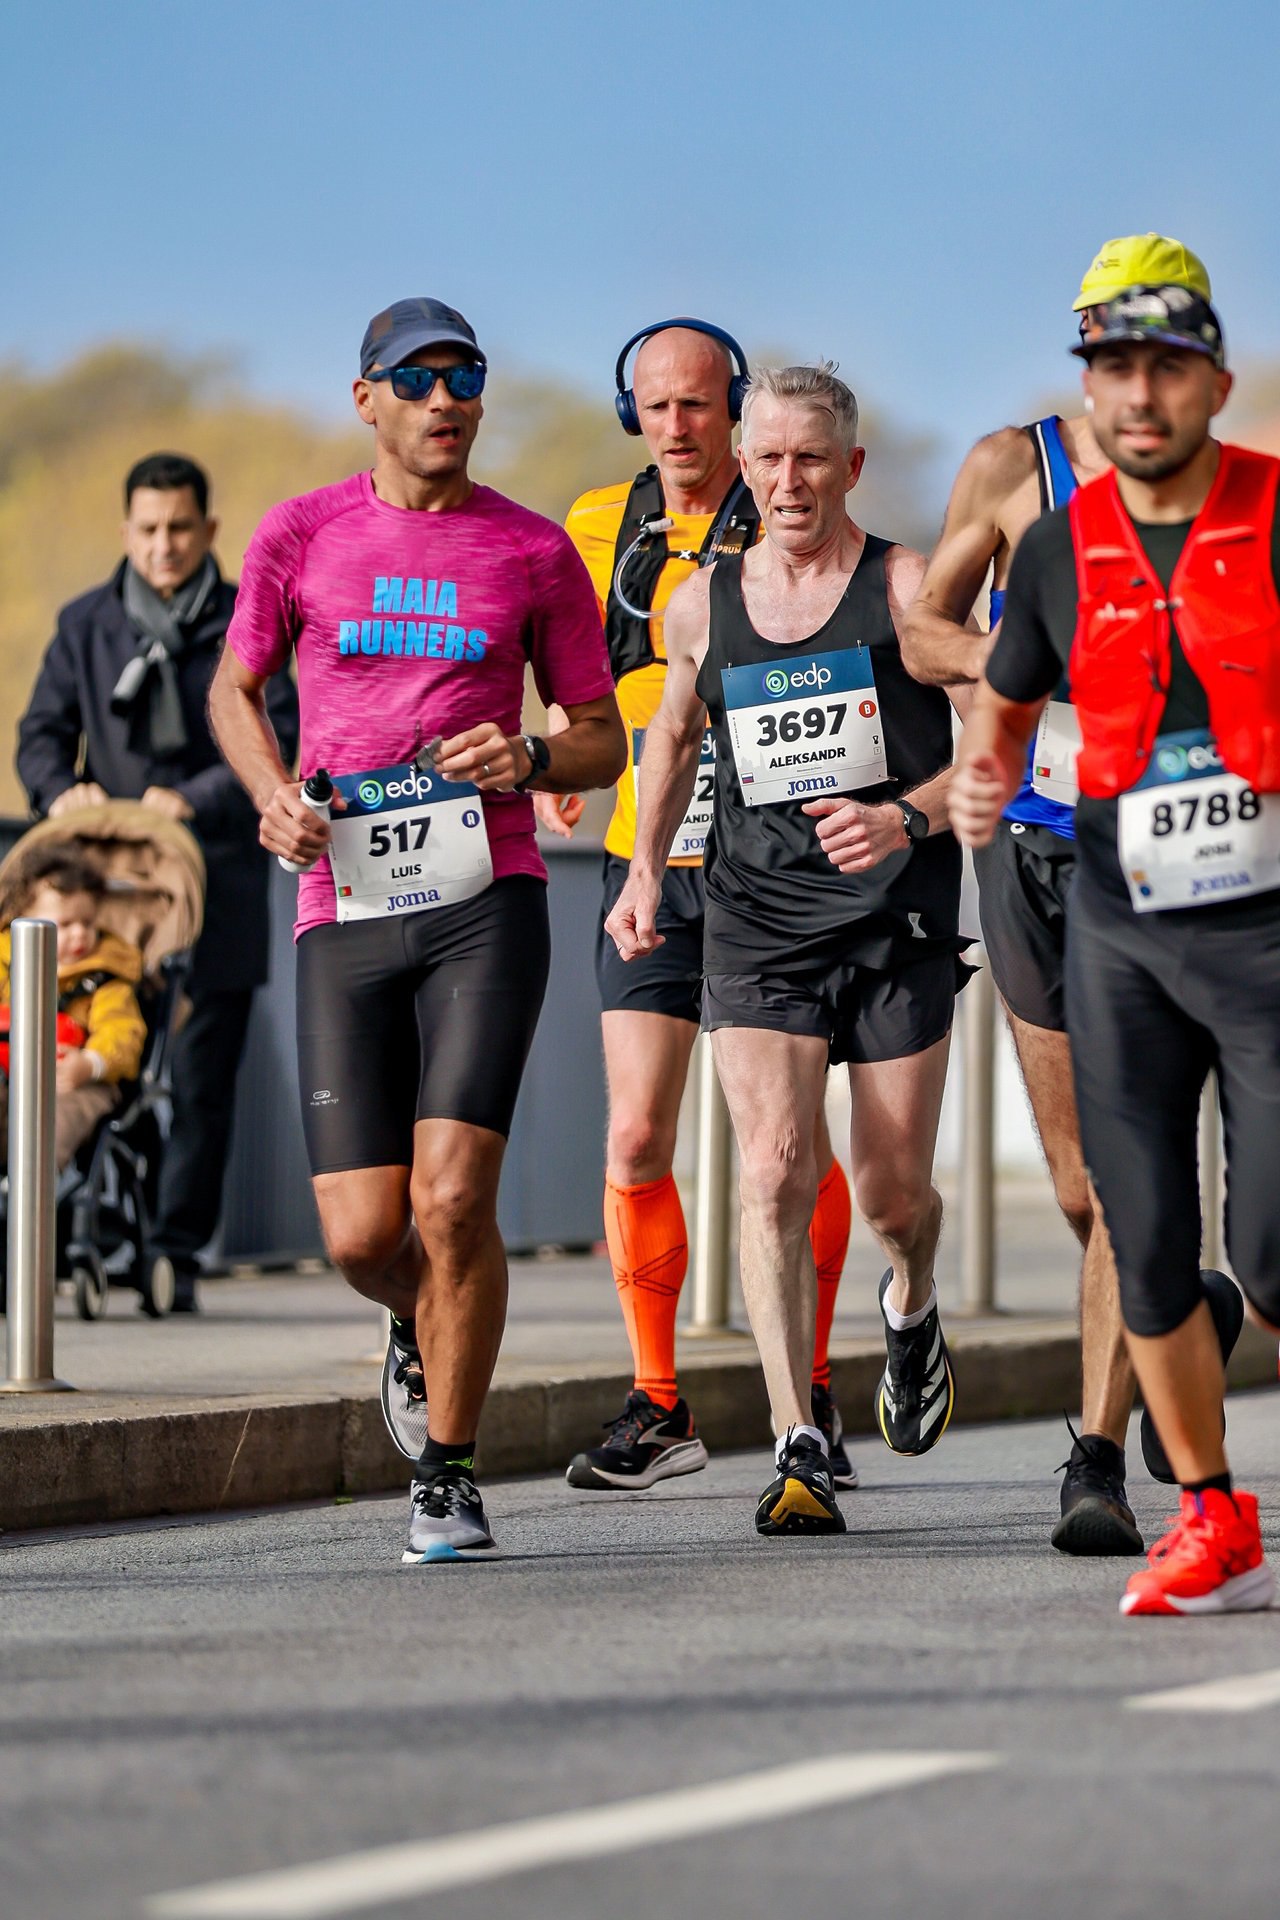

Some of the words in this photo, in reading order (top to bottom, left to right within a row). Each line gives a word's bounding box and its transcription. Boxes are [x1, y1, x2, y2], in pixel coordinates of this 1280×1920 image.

[372, 576, 458, 618] MAIA
[339, 620, 488, 662] RUNNERS
[790, 662, 831, 690] edp
[756, 703, 847, 747] 3697
[863, 704, 871, 715] B
[769, 747, 846, 769] ALEKSANDR
[386, 766, 433, 800] edp
[465, 812, 476, 826] A
[1153, 788, 1260, 836] 8788
[368, 816, 431, 857] 517
[391, 864, 422, 879] LUIS
